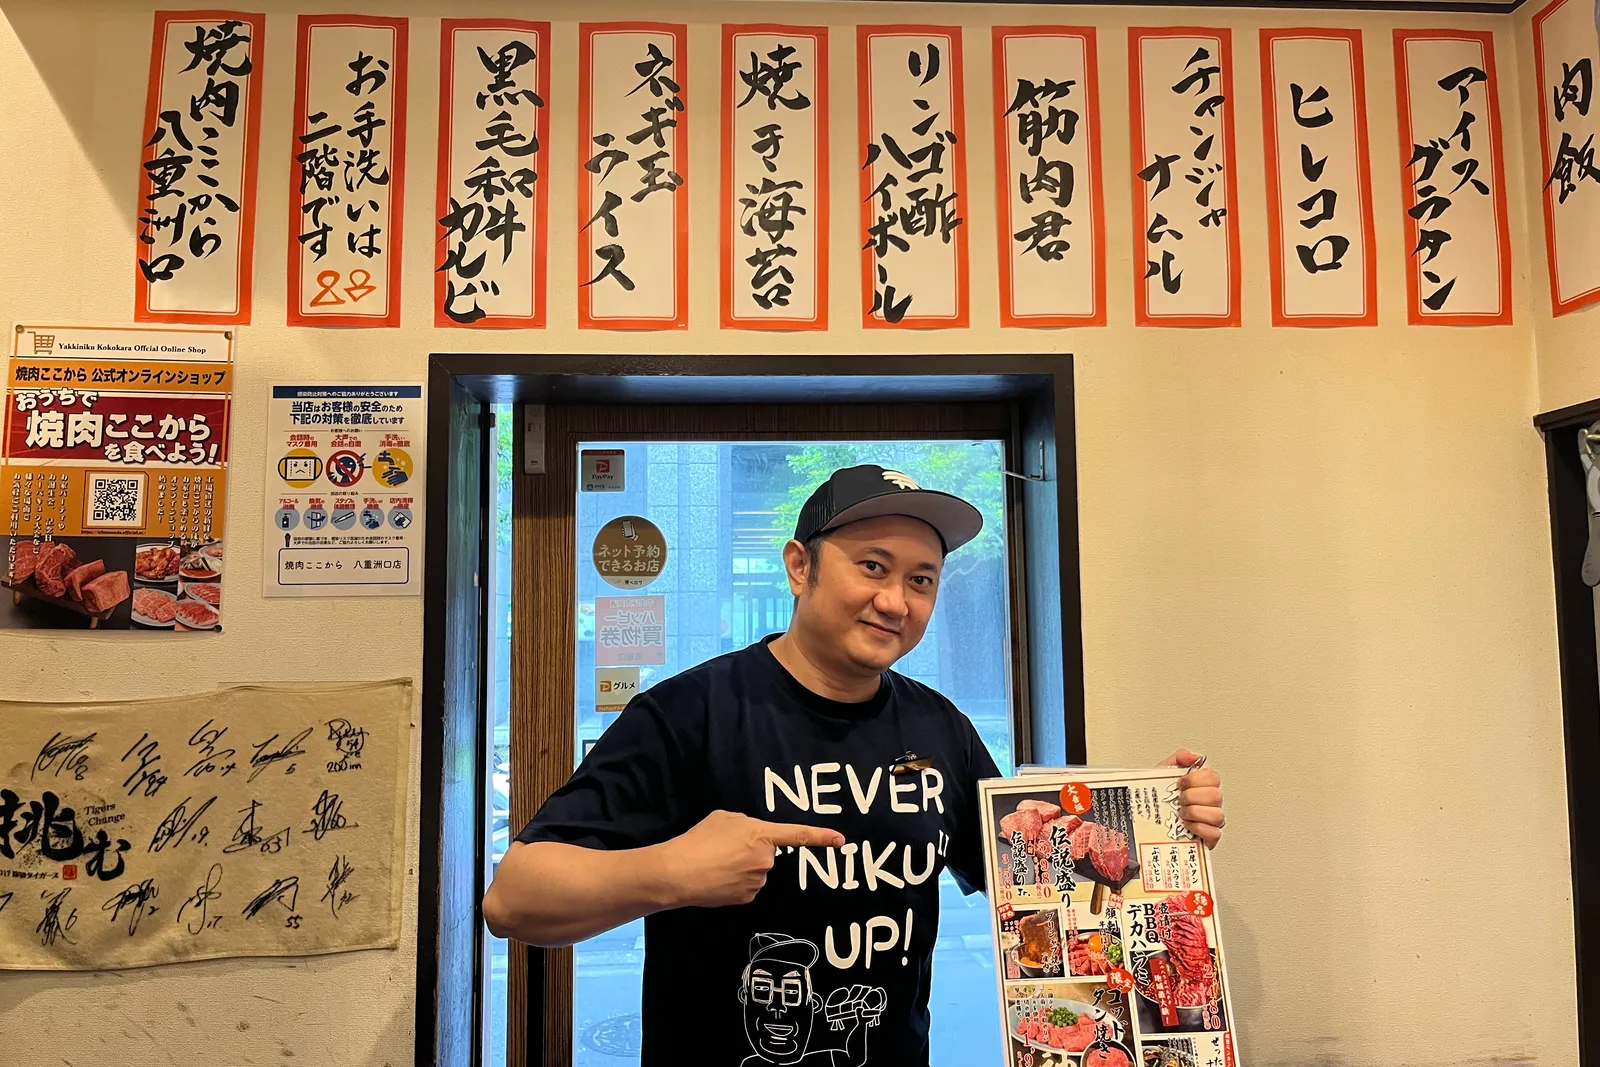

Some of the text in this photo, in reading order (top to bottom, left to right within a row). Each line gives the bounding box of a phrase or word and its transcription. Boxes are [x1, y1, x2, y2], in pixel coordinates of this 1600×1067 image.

[346, 50, 389, 259] お手洗いは
[464, 40, 544, 264] 黒毛和牛
[624, 43, 685, 202] ネギ玉
[906, 43, 964, 244] リンゴ酢
[1171, 47, 1226, 228] チャンジャ
[1437, 66, 1490, 196] アイス
[1543, 58, 1600, 204] 肉飯
[138, 110, 194, 283] 八重洲口
[298, 110, 342, 263] 二階です
[736, 43, 811, 309] 焼き海苔
[1003, 78, 1080, 262] 筋肉君
[1290, 82, 1350, 274] ヒレコロ
[579, 132, 636, 291] ライス
[862, 133, 913, 324] ハイボール
[1137, 154, 1184, 294] ナムル
[1404, 137, 1458, 311] グラタン
[436, 197, 500, 324] カルビ
[15, 366, 226, 386] 焼肉ここから 公式オンラインショップ
[58, 342, 207, 355] Yakkiniku Kokokara Offcial Online Shop
[16, 387, 99, 412] おうちで
[25, 410, 211, 449] 焼肉ここから
[290, 413, 405, 425] 下記の対策を徹底しています
[292, 401, 403, 413] 当店はお客様の安全のため
[285, 560, 402, 570] 焼肉ここから 八重洲口店
[598, 544, 660, 558] ネット予約
[598, 559, 660, 572] できるお店
[613, 682, 635, 690] グルメ
[84, 803, 116, 816] Tigers
[88, 813, 126, 827] Change
[764, 762, 945, 815] NEVER
[1049, 826, 1077, 909] 伝説盛り
[825, 908, 913, 970] UP!
[1127, 904, 1149, 986] デカハラミ
[1143, 903, 1160, 944] BBQ
[1107, 985, 1129, 1041] ゴッド
[1110, 972, 1131, 989] 限定
